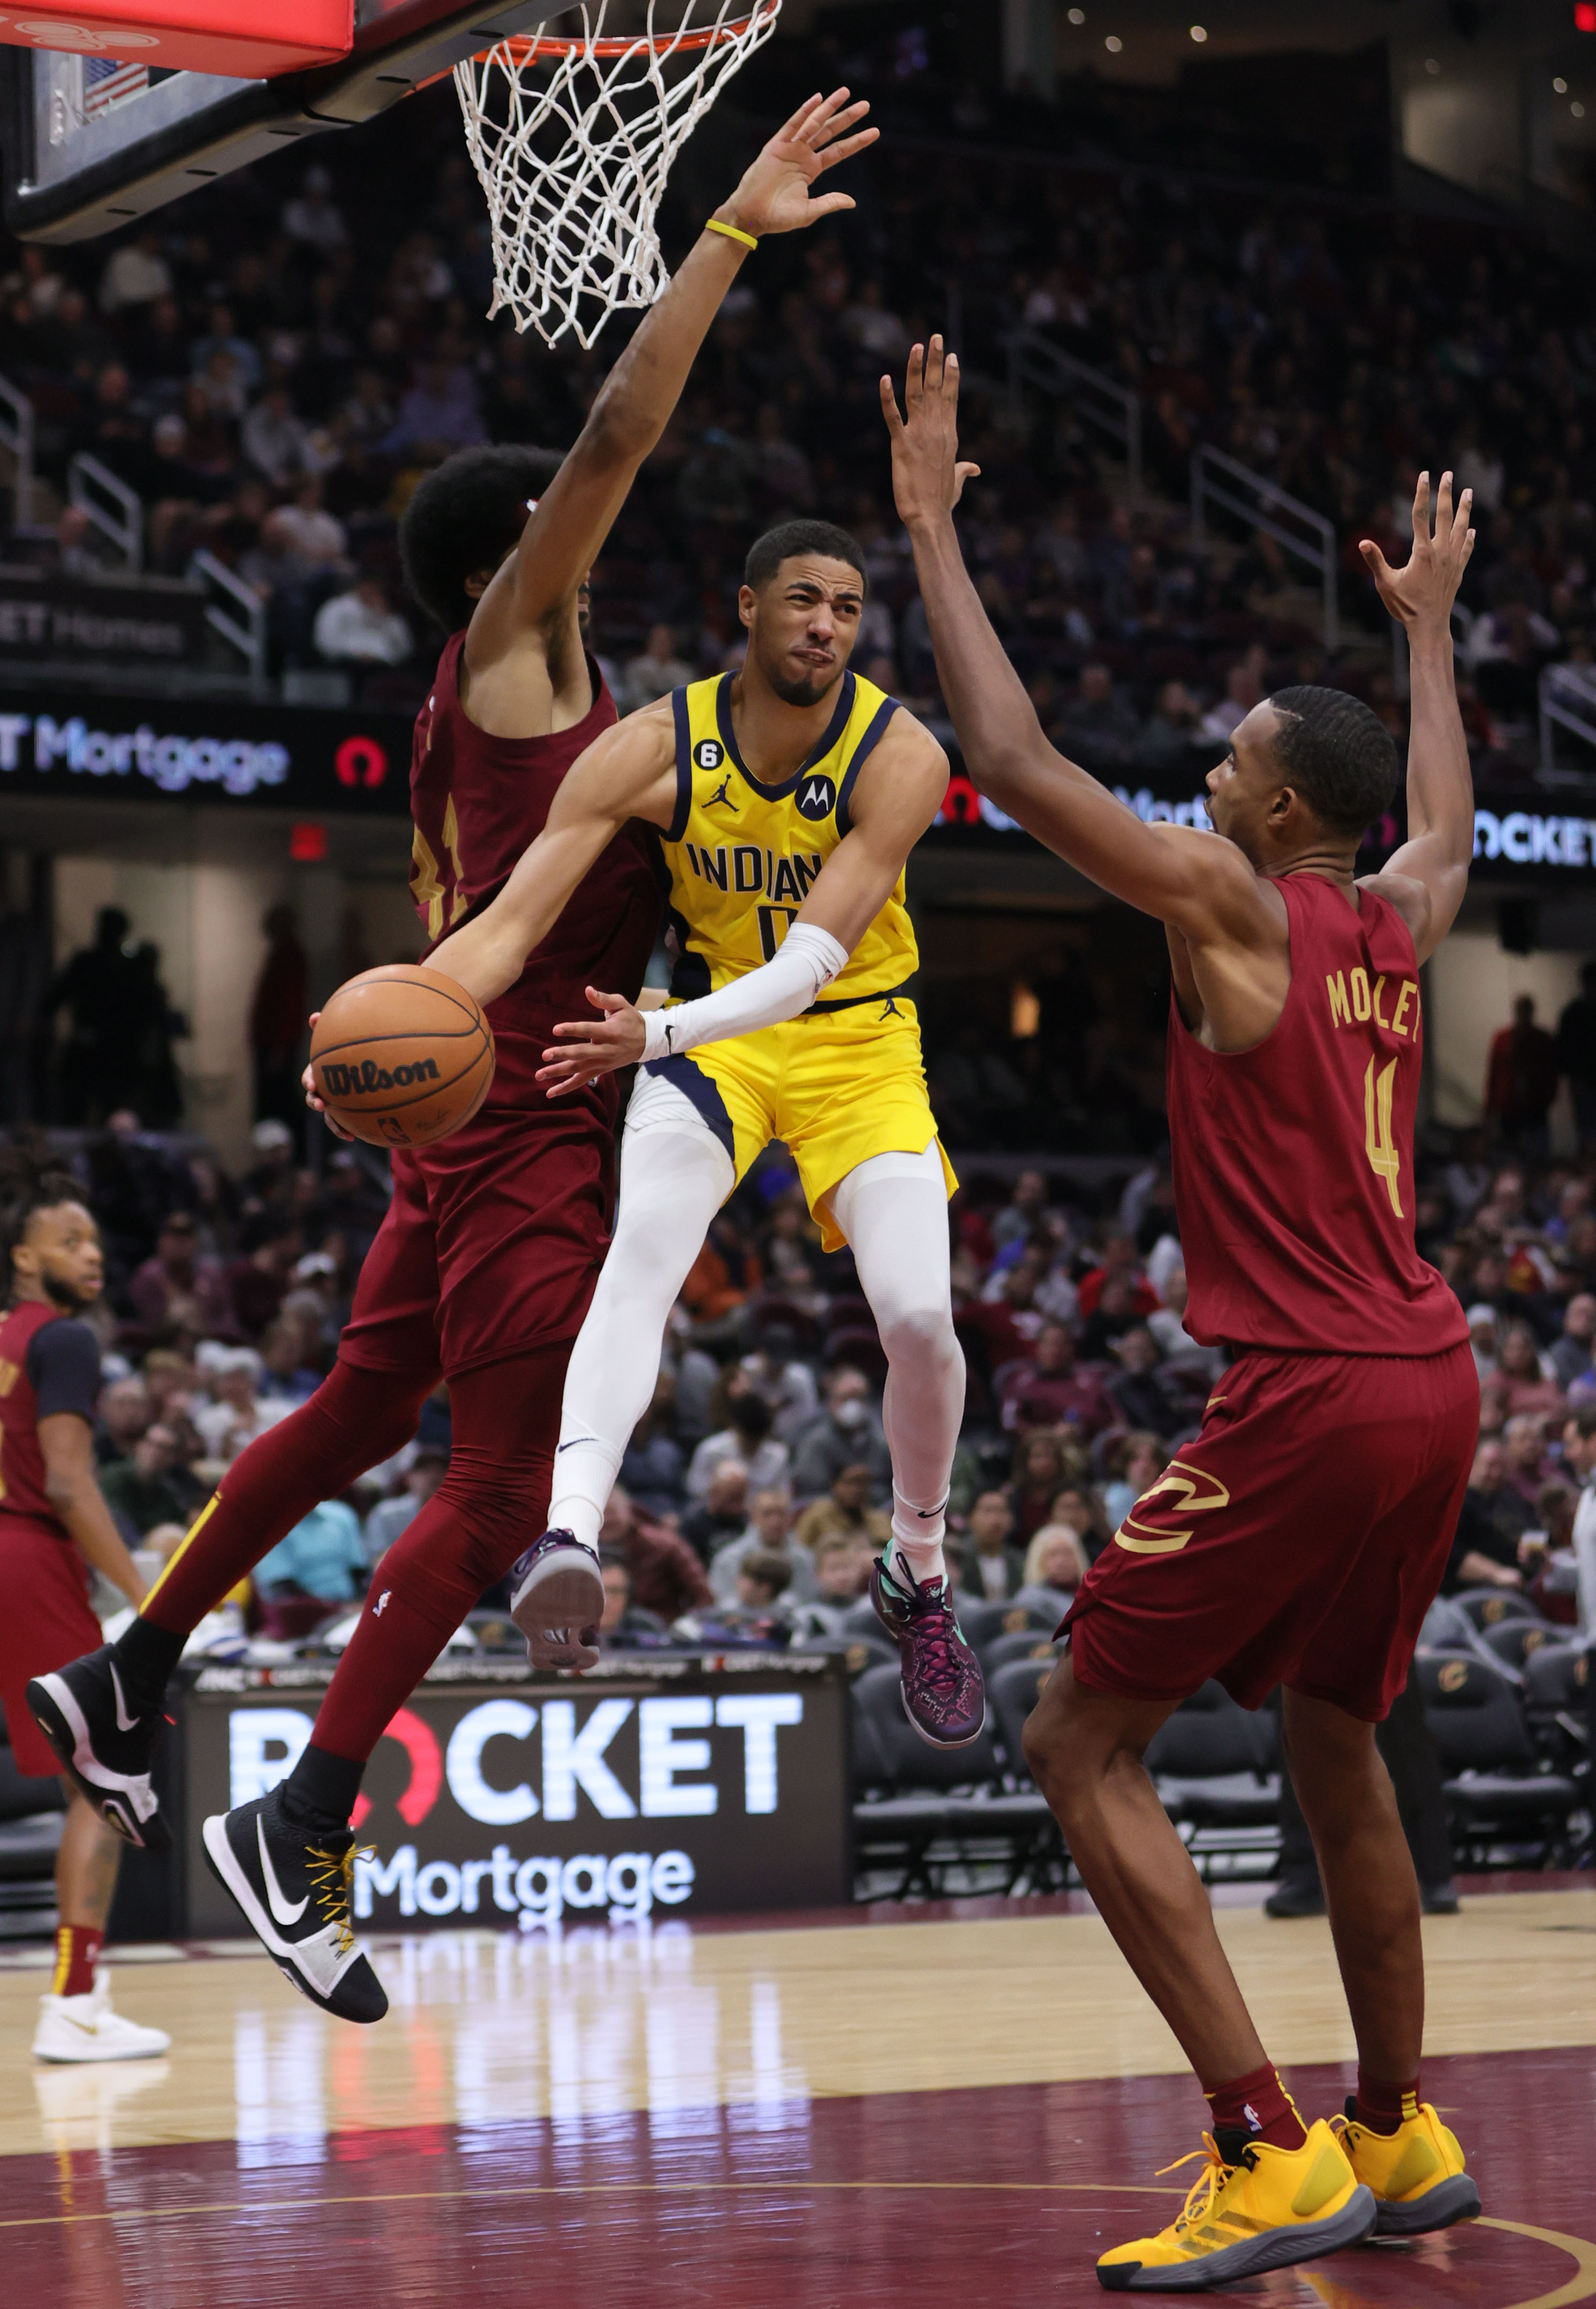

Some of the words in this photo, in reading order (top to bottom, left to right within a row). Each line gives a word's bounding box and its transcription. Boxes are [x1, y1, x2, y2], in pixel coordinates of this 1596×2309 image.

[35, 714, 290, 796] Mortgage
[700, 743, 717, 767] 6
[686, 843, 823, 904] INDIAN
[321, 1058, 440, 1096] Wilson
[1364, 1053, 1404, 1218] 4
[353, 1844, 695, 1929] Mortgage
